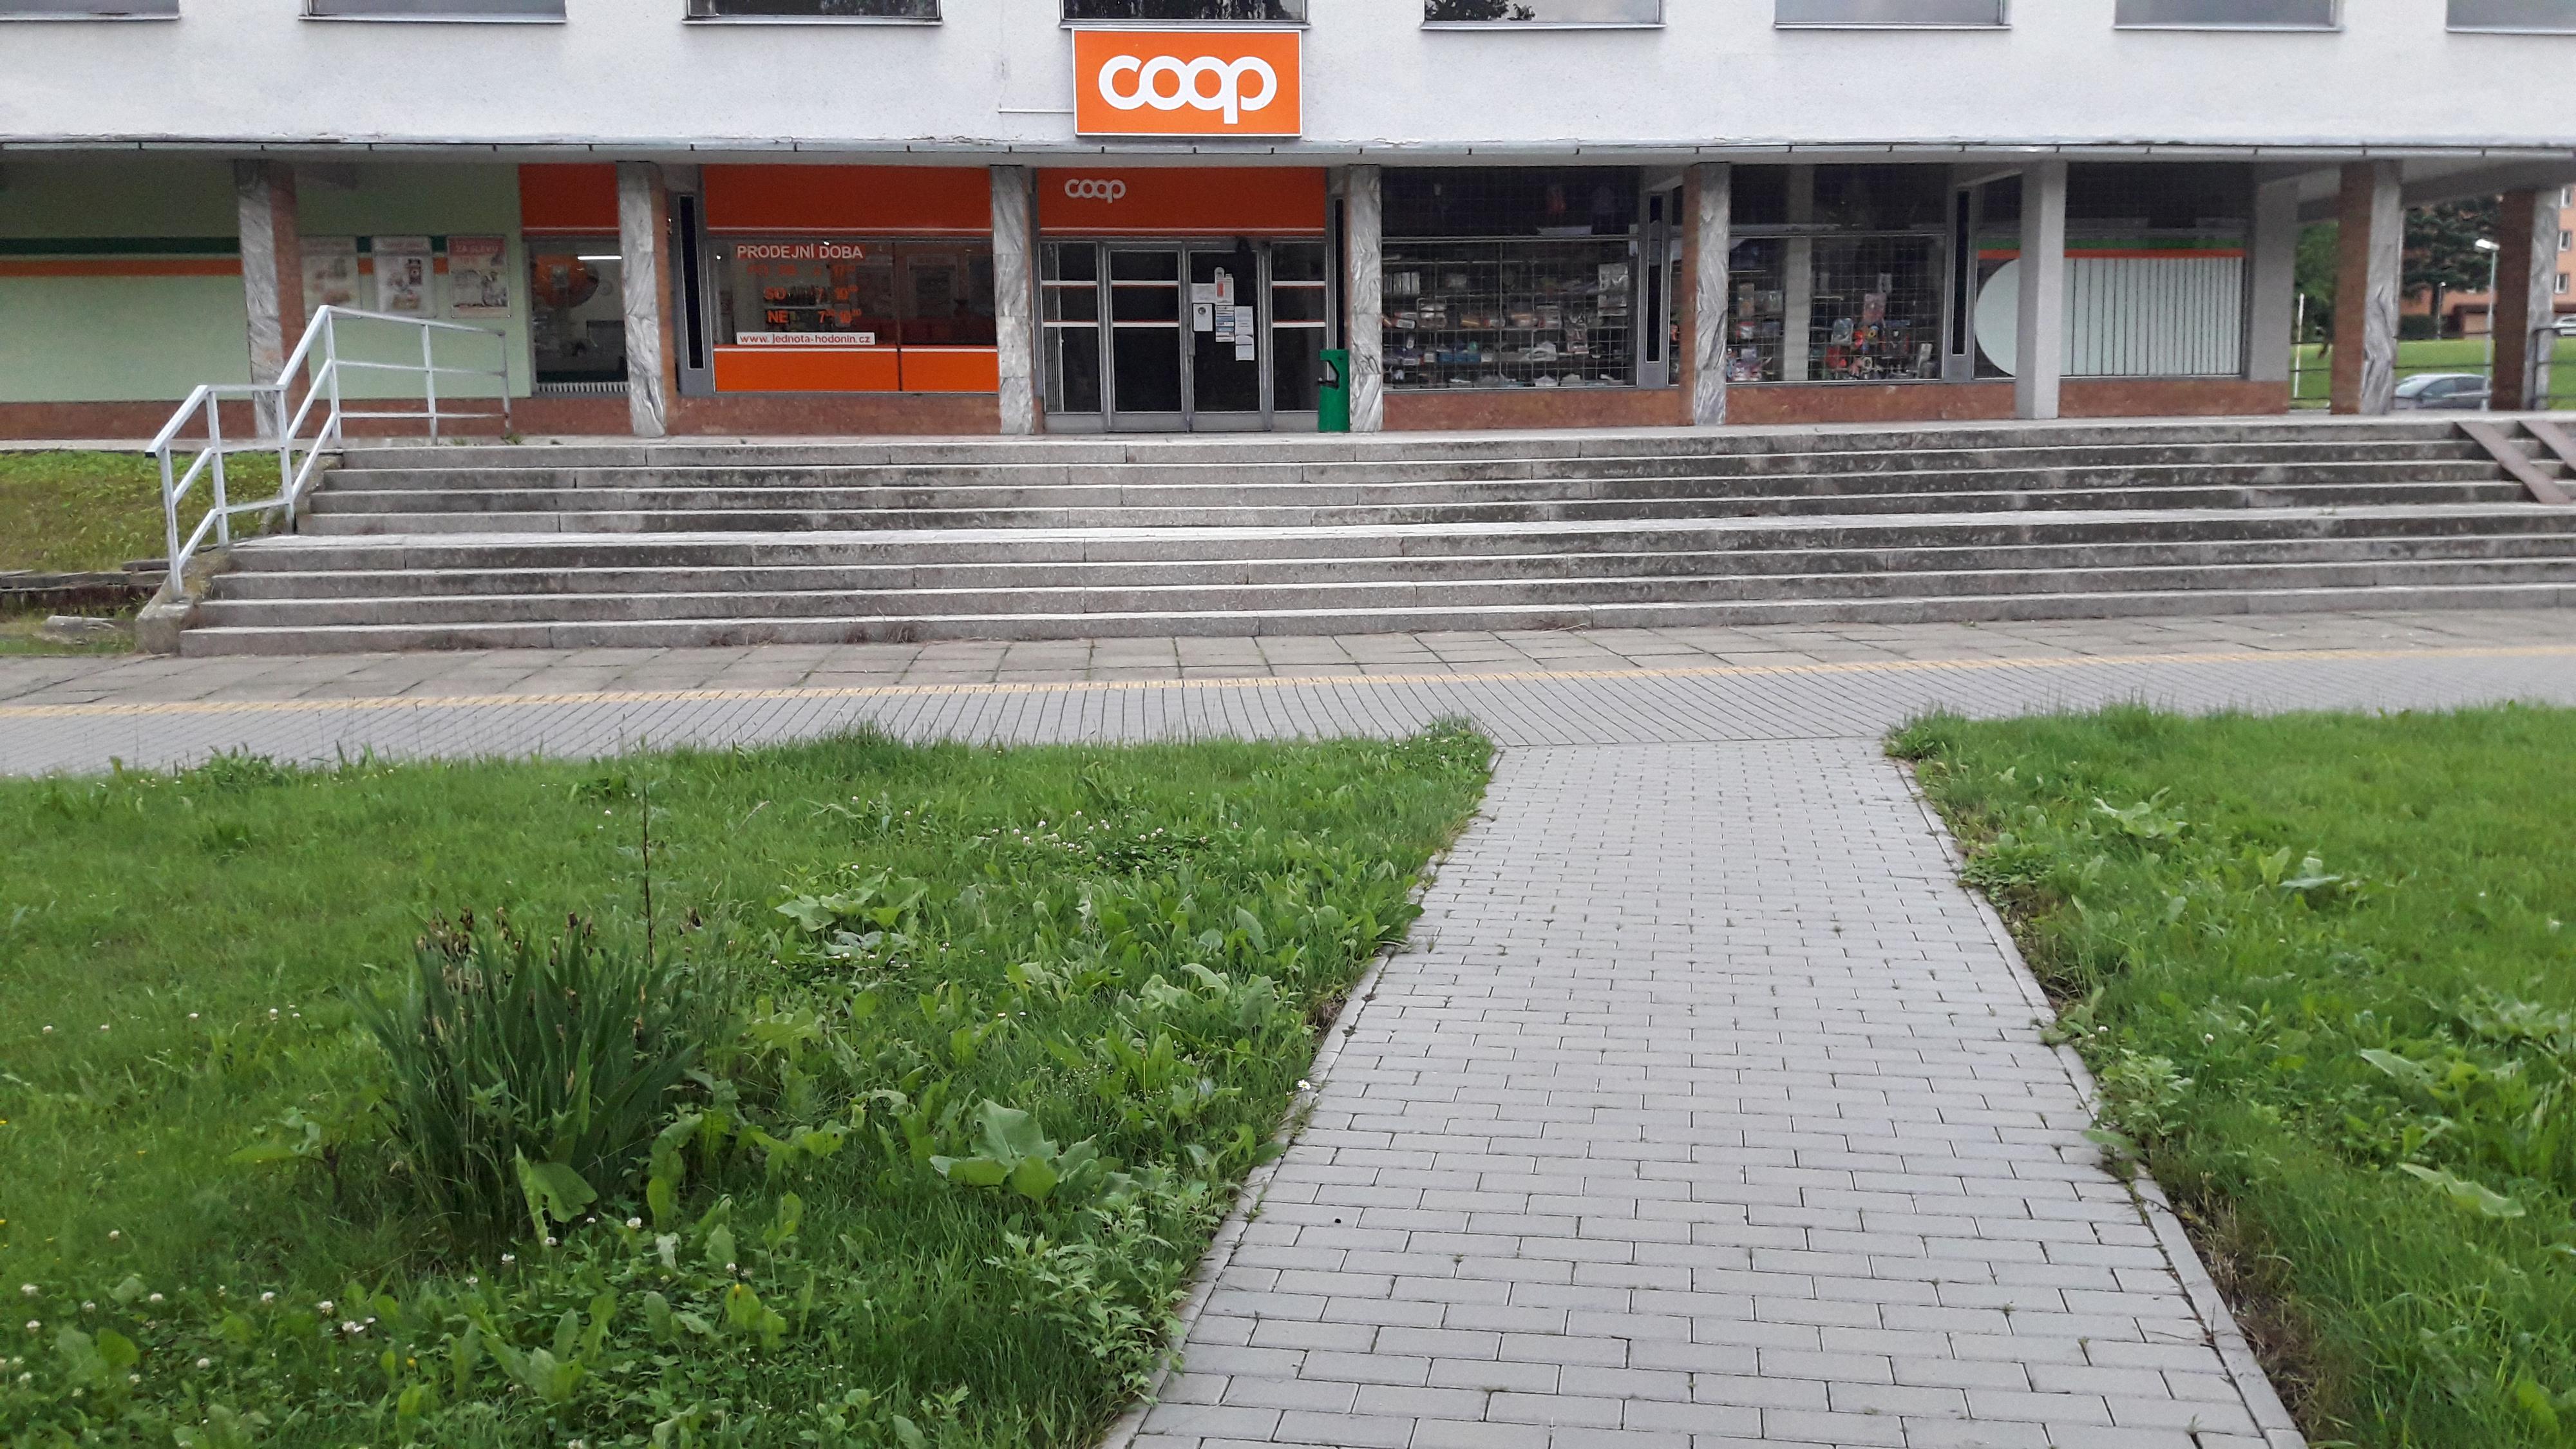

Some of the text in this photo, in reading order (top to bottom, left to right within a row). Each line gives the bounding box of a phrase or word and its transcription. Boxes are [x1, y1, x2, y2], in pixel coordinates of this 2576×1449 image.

[1098, 55, 1278, 124] coop
[1065, 179, 1126, 204] coop
[737, 243, 864, 259] PRODEJNÍ DOBA
[767, 310, 790, 323] NE
